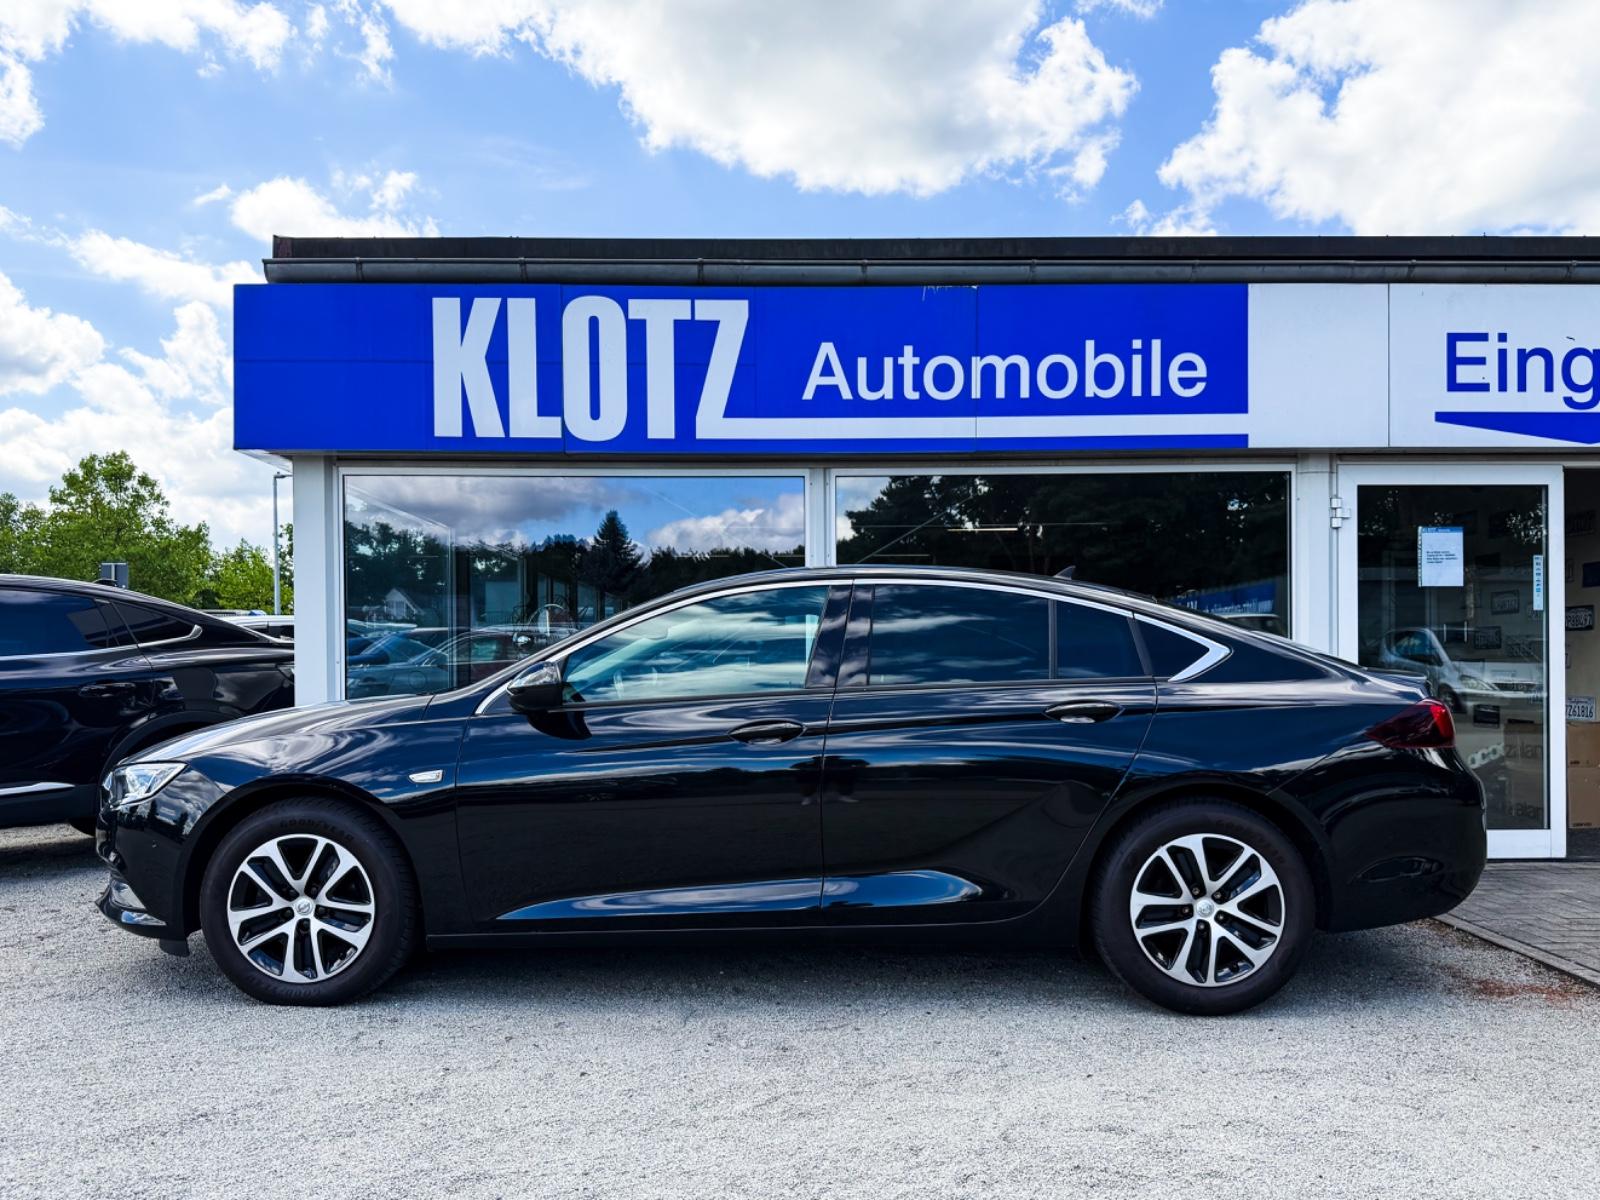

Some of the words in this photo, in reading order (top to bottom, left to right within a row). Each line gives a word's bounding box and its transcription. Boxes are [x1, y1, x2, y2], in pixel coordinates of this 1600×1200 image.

[432, 295, 749, 441] KLOTZ
[802, 339, 1207, 400] Automobile
[1447, 332, 1600, 410] Eing
